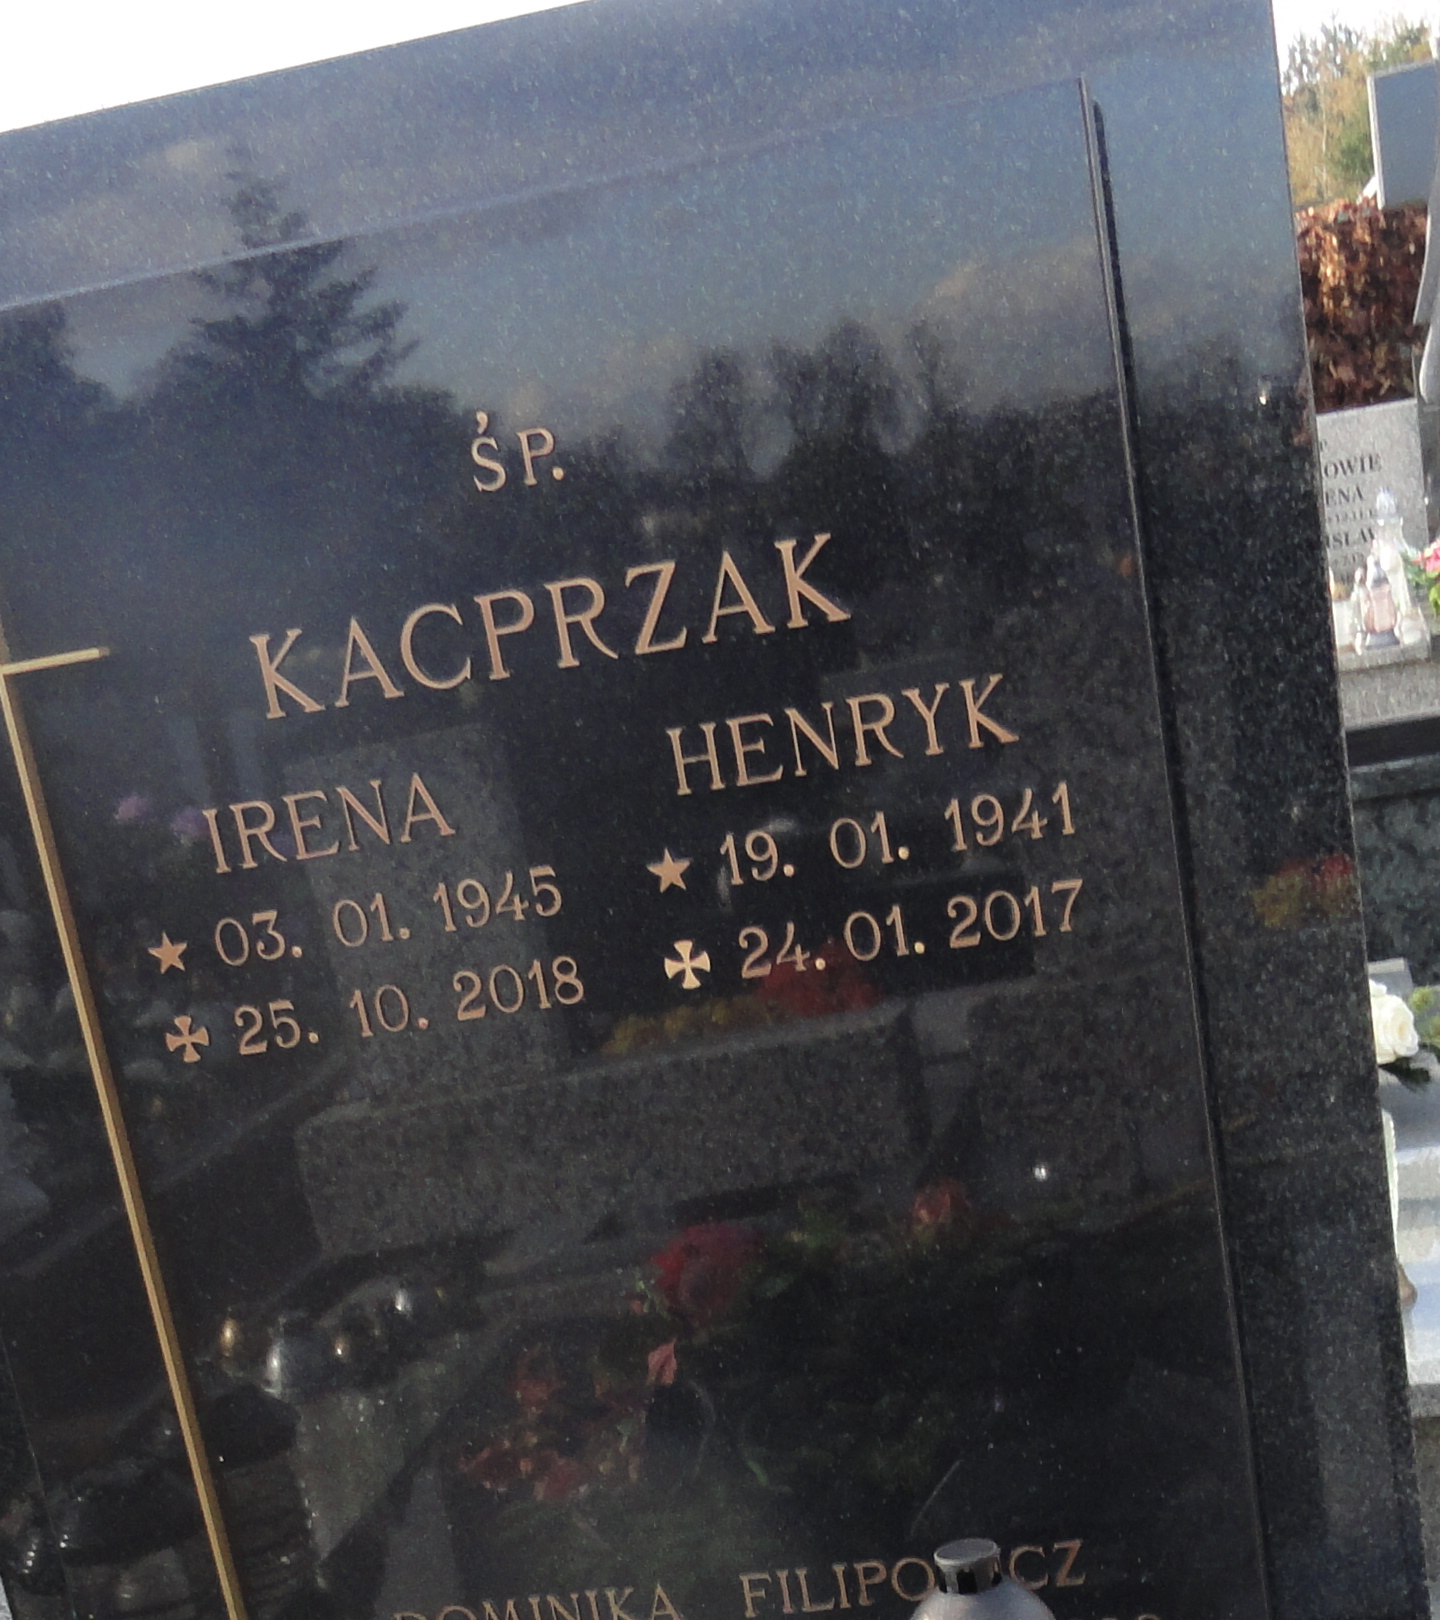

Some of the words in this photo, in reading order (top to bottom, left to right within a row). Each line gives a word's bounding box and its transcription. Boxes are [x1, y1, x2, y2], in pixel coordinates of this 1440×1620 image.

[250, 533, 851, 719] KACPRZAK
[665, 673, 1020, 795] HENRYK
[201, 773, 455, 873] IRENA
[720, 832, 796, 886] 19.
[829, 811, 910, 864] 01.
[944, 781, 1076, 852] 1941
[214, 909, 303, 966] 03.
[332, 893, 411, 946] 01.
[432, 865, 563, 932] 1945
[738, 922, 827, 979] 24.
[844, 905, 926, 961] 01.
[946, 879, 1084, 949] 2017
[234, 999, 320, 1055] 25.
[349, 983, 430, 1038] 10.
[452, 955, 585, 1021] 2018
[739, 1539, 1087, 1618] FILIPOCZ
